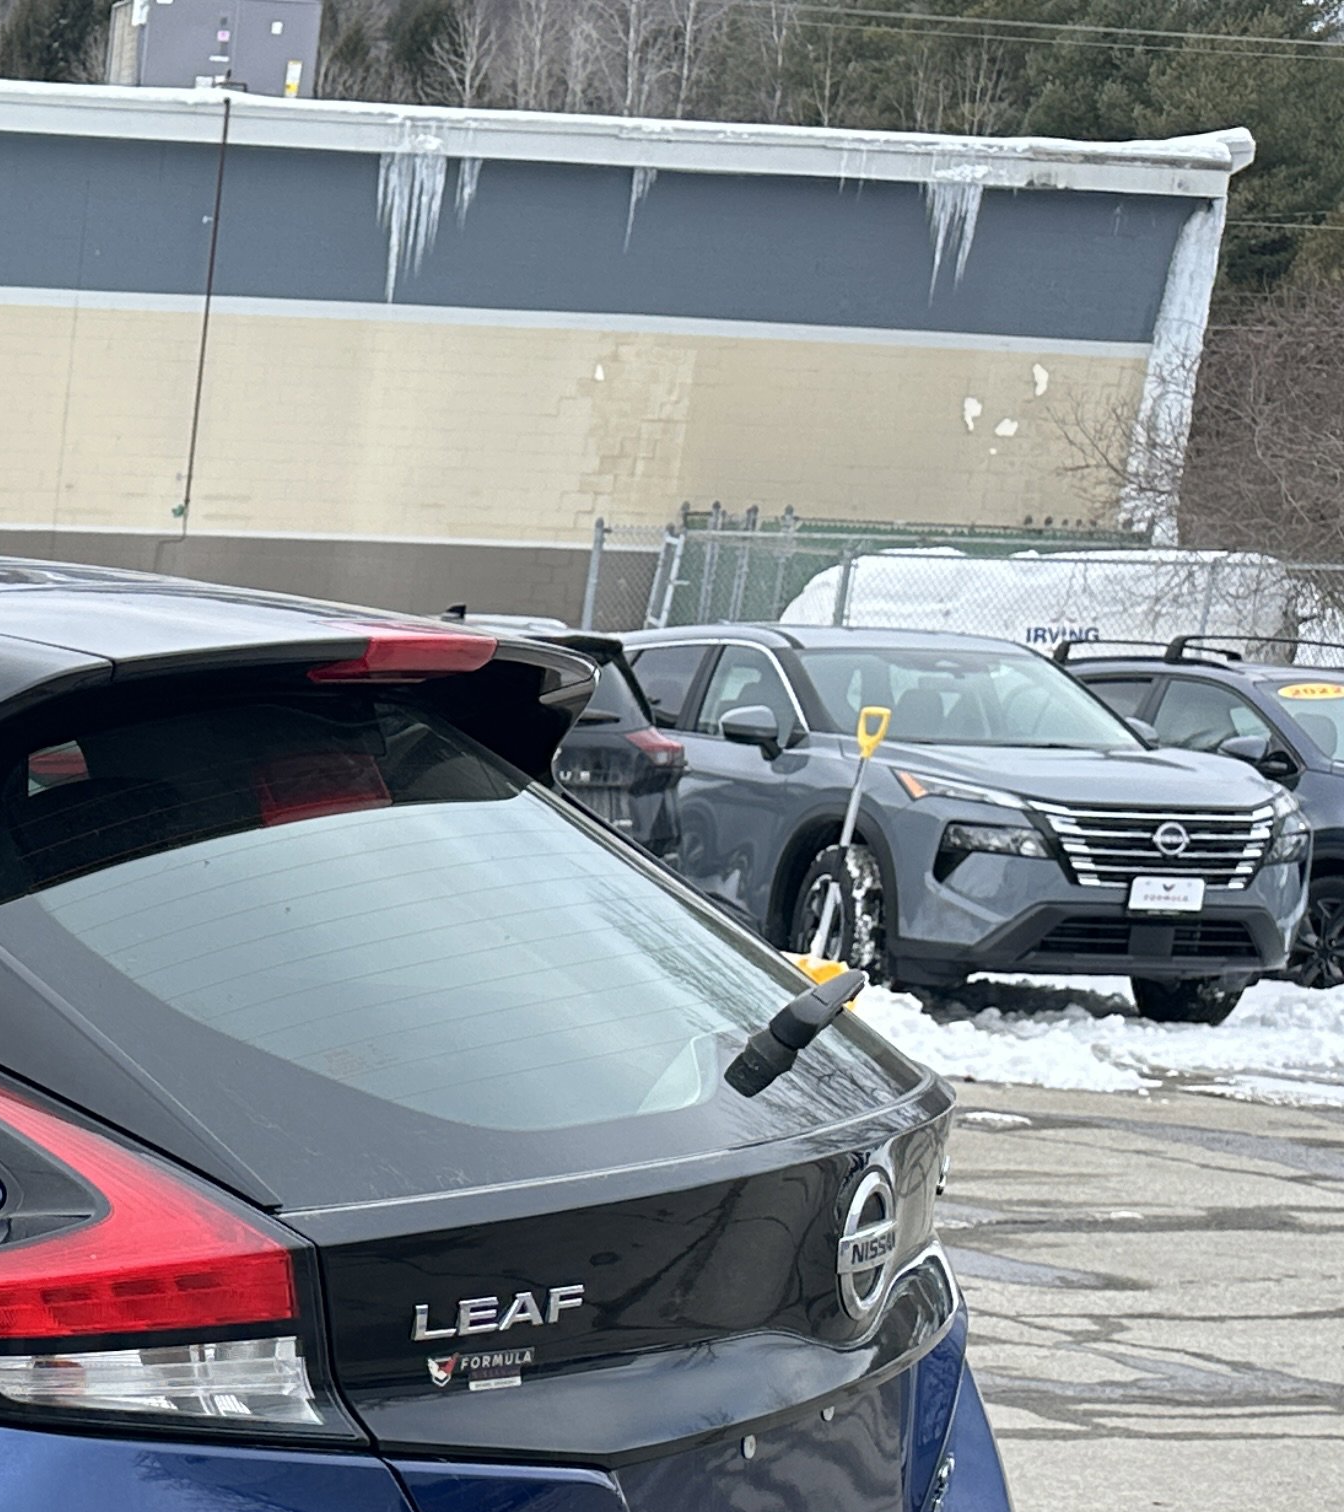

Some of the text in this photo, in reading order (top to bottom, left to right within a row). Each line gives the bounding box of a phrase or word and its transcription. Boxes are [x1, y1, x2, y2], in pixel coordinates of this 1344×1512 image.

[1025, 626, 1100, 643] IRVING
[412, 1284, 584, 1341] LEAF
[460, 1351, 532, 1371] FORMULA
